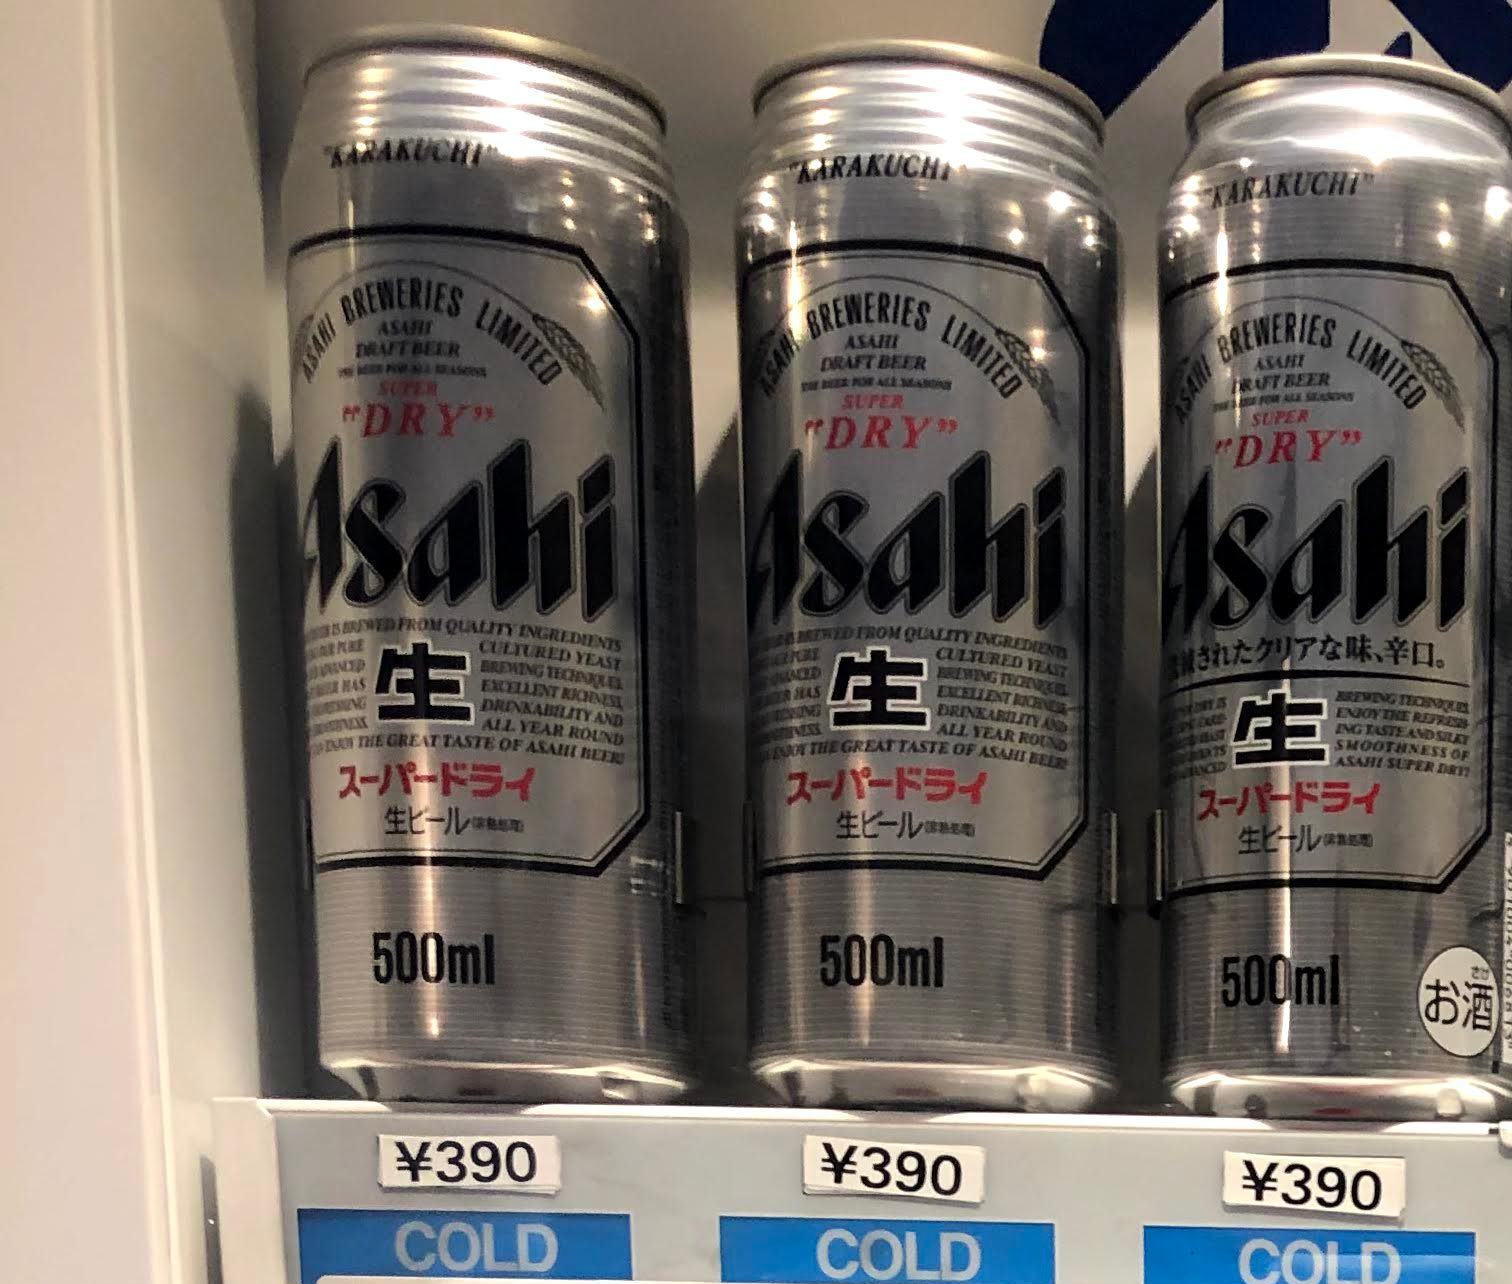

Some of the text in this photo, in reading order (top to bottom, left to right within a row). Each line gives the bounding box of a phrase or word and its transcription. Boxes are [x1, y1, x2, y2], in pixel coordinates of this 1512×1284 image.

[340, 276, 563, 386] BREWERIES LIMITED
[806, 292, 1024, 400] BREWERIES LIMITED
[1217, 312, 1427, 410] BREWERIES LIMITED
[1252, 408, 1309, 427] SUPER
[303, 435, 617, 624] Asahi
[746, 449, 1067, 630] Asahi
[1164, 455, 1471, 633] Asahi
[374, 641, 476, 726] 生
[828, 646, 931, 731] 生
[1231, 688, 1330, 769] 生
[338, 765, 536, 801] スーパードライ
[785, 767, 988, 806] スーパードライ
[1198, 781, 1381, 822] スーパードライ
[372, 932, 496, 985] 500ml
[820, 934, 945, 988] 500ml
[1222, 955, 1341, 1008] 500ml
[394, 1140, 538, 1183] ¥390
[820, 1142, 963, 1197] ¥390
[1242, 1160, 1383, 1212] ¥390
[395, 1221, 559, 1274] COLD
[816, 1228, 982, 1282] COLD
